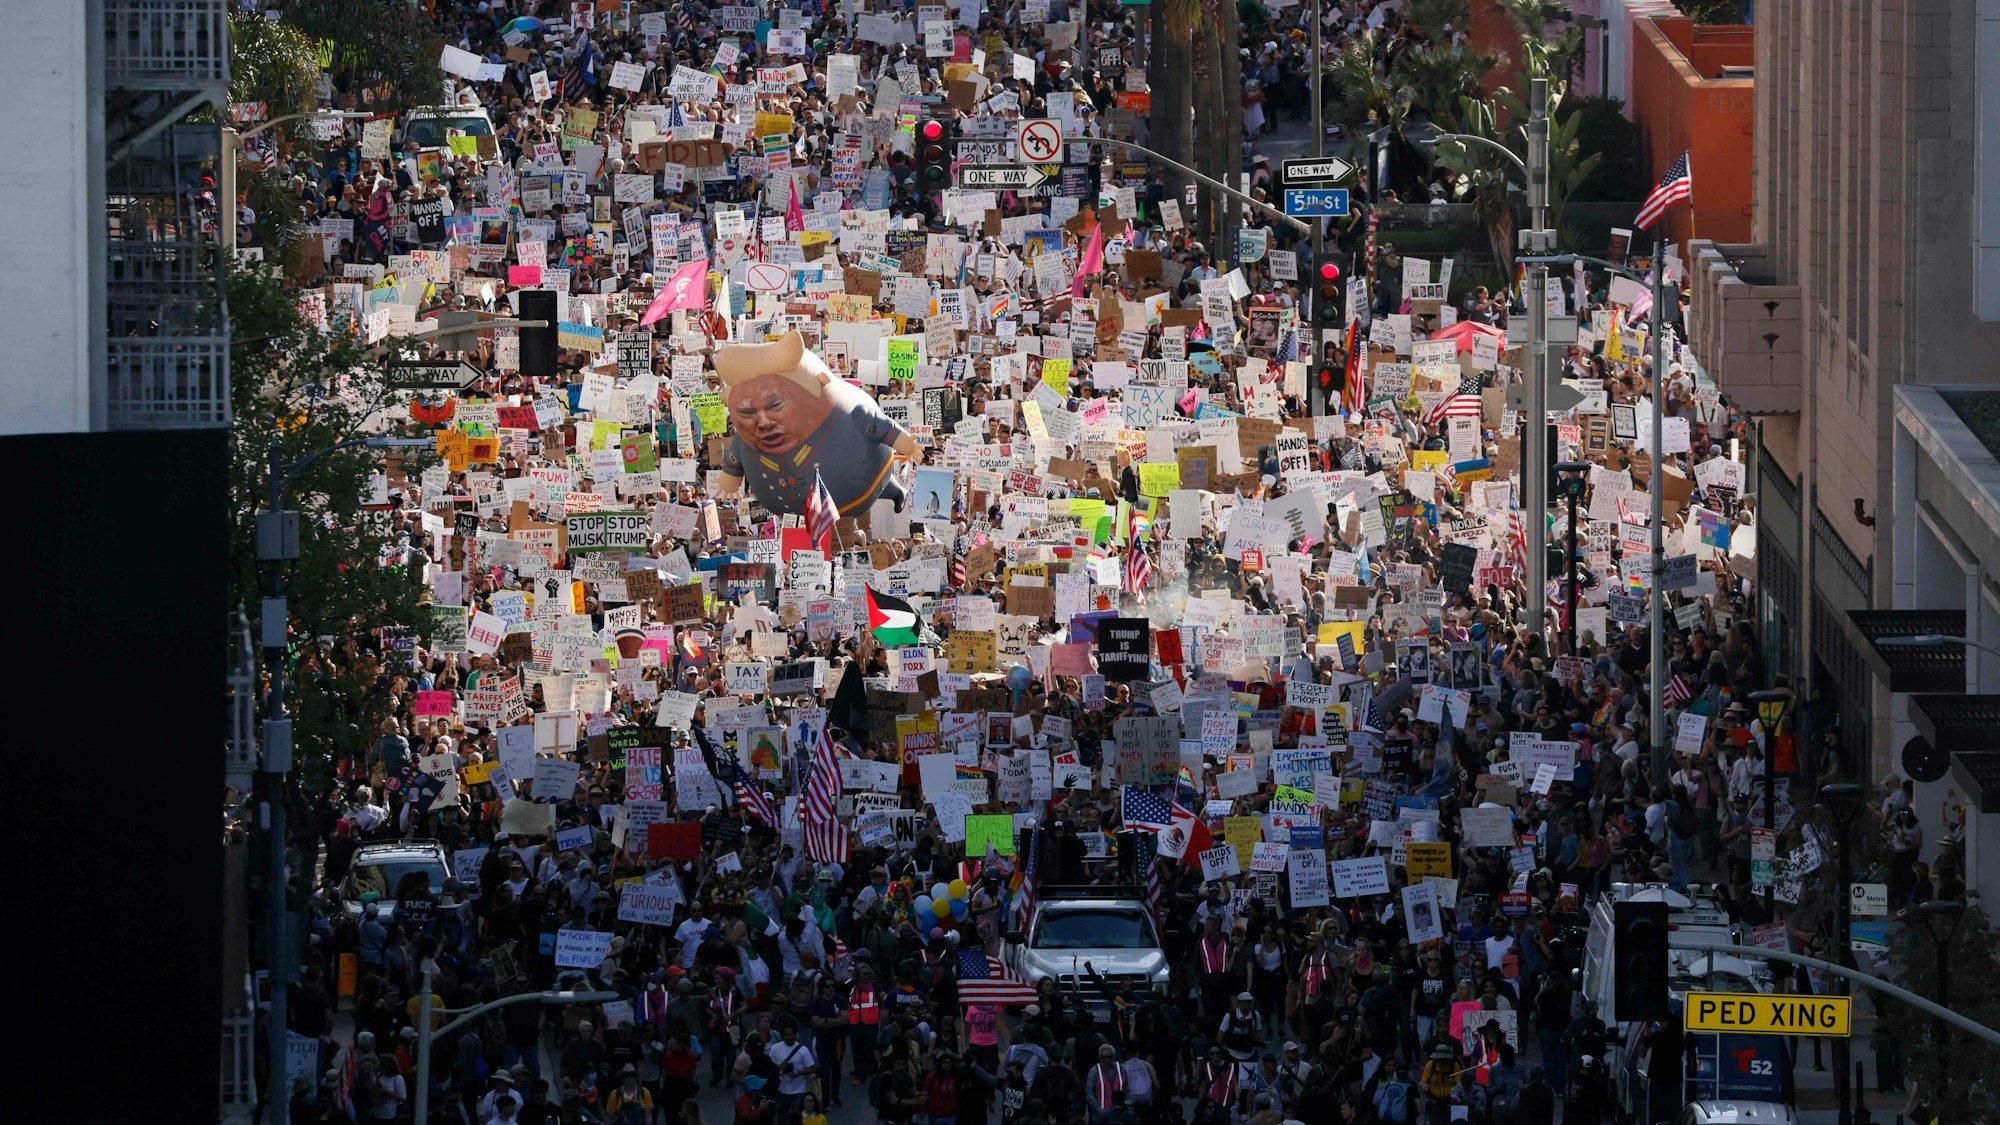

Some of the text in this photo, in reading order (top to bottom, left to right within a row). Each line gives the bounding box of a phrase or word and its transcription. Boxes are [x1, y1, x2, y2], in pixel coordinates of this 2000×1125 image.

[1100, 55, 1121, 66] OFF!
[961, 145, 997, 154] HANDS
[1290, 165, 1331, 176] ONE WAY
[970, 171, 1027, 183] ONE WAY
[413, 200, 442, 216] HANDS
[1294, 194, 1340, 211] 5th St
[418, 214, 440, 227] OFF
[346, 267, 376, 277] Hands
[567, 324, 596, 335] STAND
[618, 349, 648, 360] IS THE
[432, 370, 458, 380] WAY
[890, 367, 914, 379] YOU
[1141, 362, 1166, 379] STOP!
[1129, 388, 1164, 403] TAX
[1127, 406, 1168, 424] RICH
[1277, 437, 1307, 451] HANDS
[1281, 456, 1307, 471] OFF!
[532, 471, 569, 482] TRUMP
[461, 516, 472, 526] NO
[570, 517, 645, 530] STOP STOP
[1241, 518, 1265, 530] CLEAN
[569, 532, 646, 546] MUSK TRUMP
[749, 541, 779, 552] HANDS
[753, 553, 775, 564] OFF
[728, 566, 766, 579] STOP
[492, 596, 524, 607] CONGRESS
[539, 604, 568, 614] RESIST
[810, 604, 830, 614] STOP
[609, 611, 637, 622] HANDS
[1110, 630, 1140, 639] TRUMP
[1120, 641, 1129, 650] IS
[1099, 652, 1148, 663] TARIFFYING
[736, 666, 760, 677] TAX
[903, 662, 924, 672] FORK
[726, 679, 765, 690] WEALTH
[1293, 682, 1330, 693] PEOPLE
[466, 692, 503, 702] TARIFFS
[506, 694, 523, 707] THE
[1292, 695, 1327, 704] PROFIT
[476, 703, 502, 711] TAXES
[609, 737, 639, 748] WORLD
[904, 733, 936, 747] HANDS
[628, 748, 661, 767] HATE
[1009, 760, 1024, 768] NOT
[1498, 762, 1517, 773] FUCK
[645, 767, 661, 784] US
[1002, 768, 1028, 776] TODAY
[880, 795, 898, 807] WITH
[1271, 801, 1307, 814] HANDS
[560, 836, 586, 849] TRANS
[1201, 847, 1230, 861] HANDS
[1210, 856, 1230, 868] OFF!
[1357, 863, 1382, 871] TANKING
[625, 884, 644, 893] TOO
[405, 901, 432, 909] FUCK
[621, 894, 672, 911] FURIOUS
[621, 911, 672, 924] FOR WORDS
[1700, 1002, 1836, 1027] PED XING
[1750, 1060, 1772, 1075] 52
